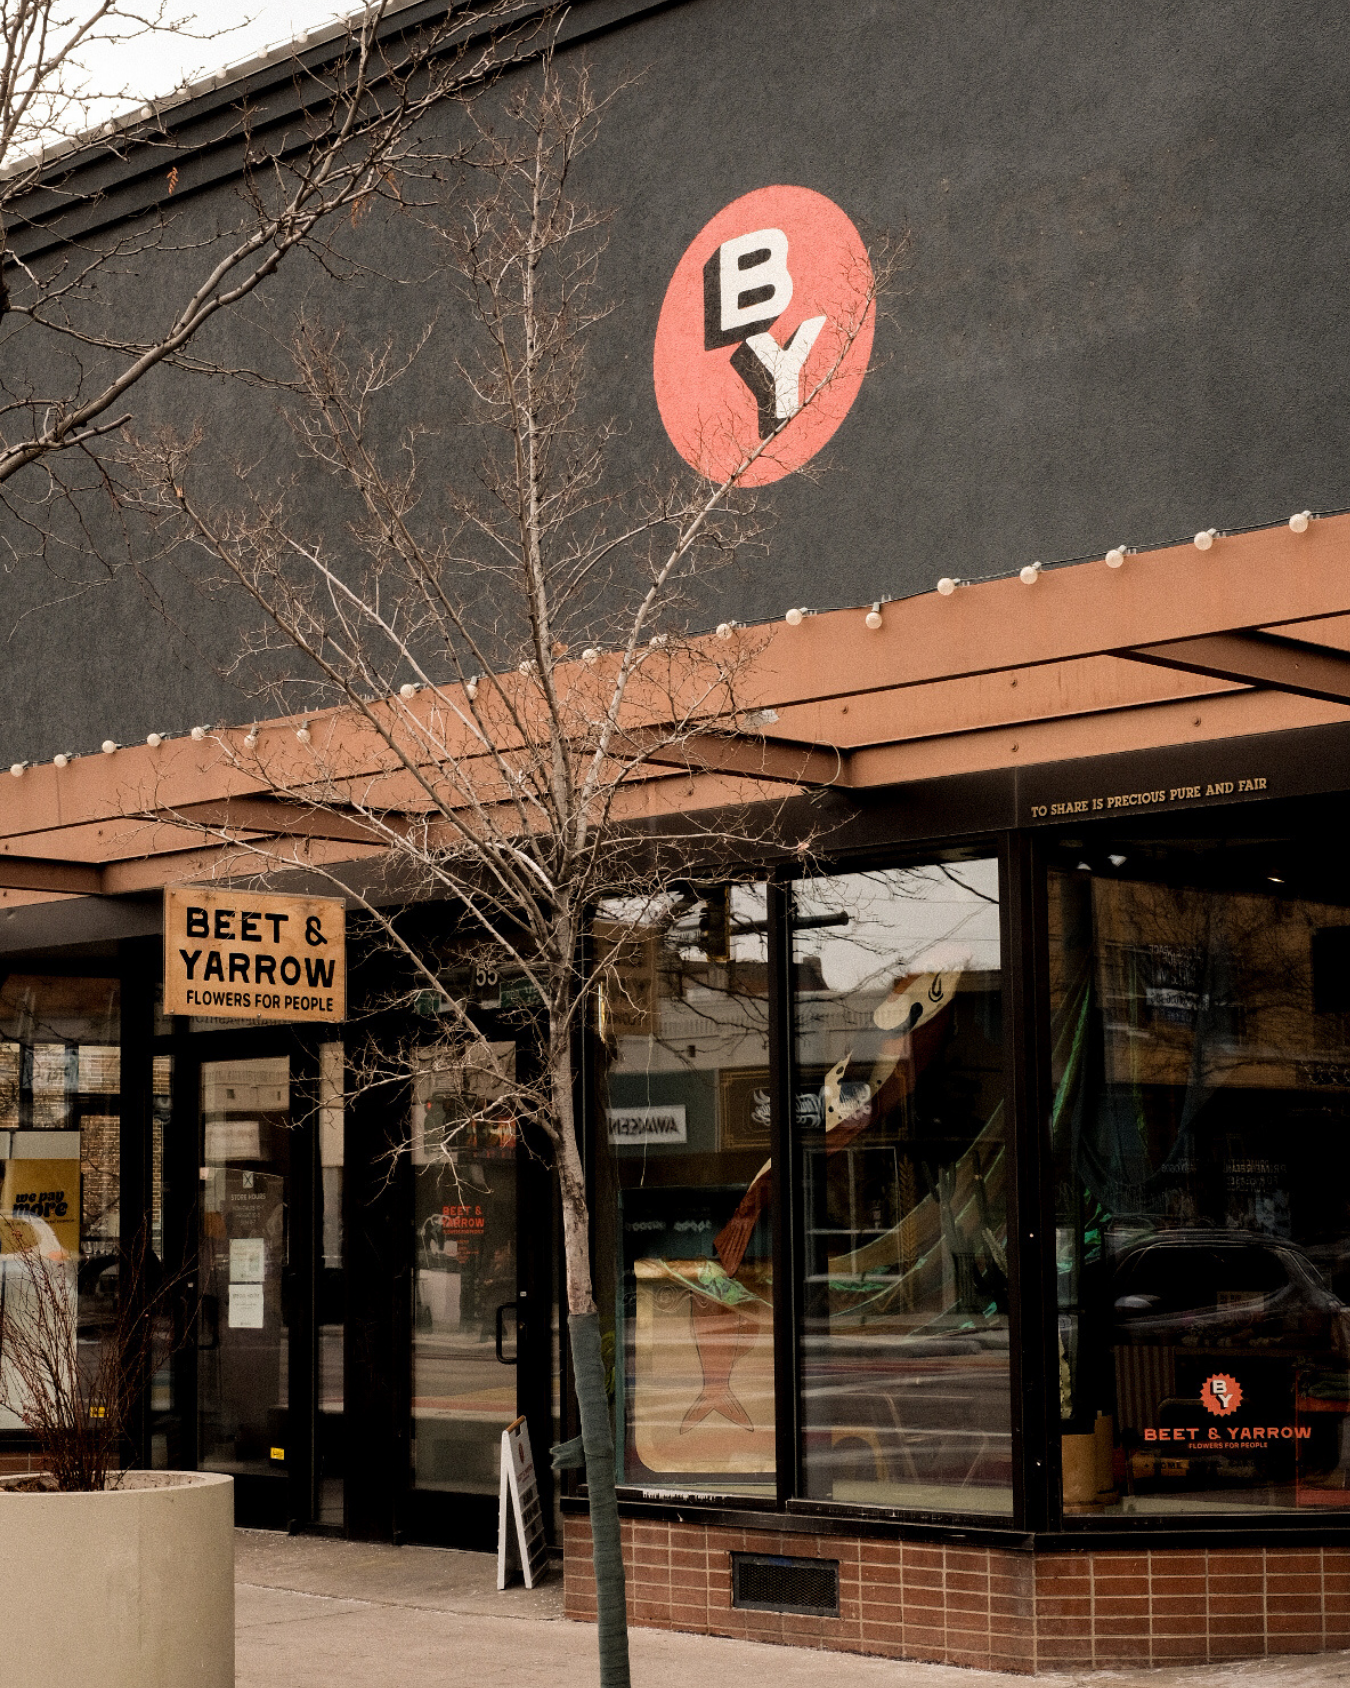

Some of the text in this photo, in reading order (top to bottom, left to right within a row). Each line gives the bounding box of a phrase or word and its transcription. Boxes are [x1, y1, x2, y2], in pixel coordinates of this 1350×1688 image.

[1031, 777, 1267, 818] TO SHARE IS PRECIOUS PURE AND FAIR
[186, 906, 328, 946] BEET &
[178, 948, 336, 988] YARROW
[476, 966, 498, 986] 55
[186, 989, 334, 1012] FLOWERS FOR PEOPLE
[16, 1190, 64, 1205] we pay
[13, 1202, 68, 1218] more
[442, 1205, 482, 1215] BEET &
[442, 1216, 485, 1227] YARROW
[1144, 1427, 1312, 1441] BEET & YARROW
[1240, 1441, 1268, 1449] PEOPLE
